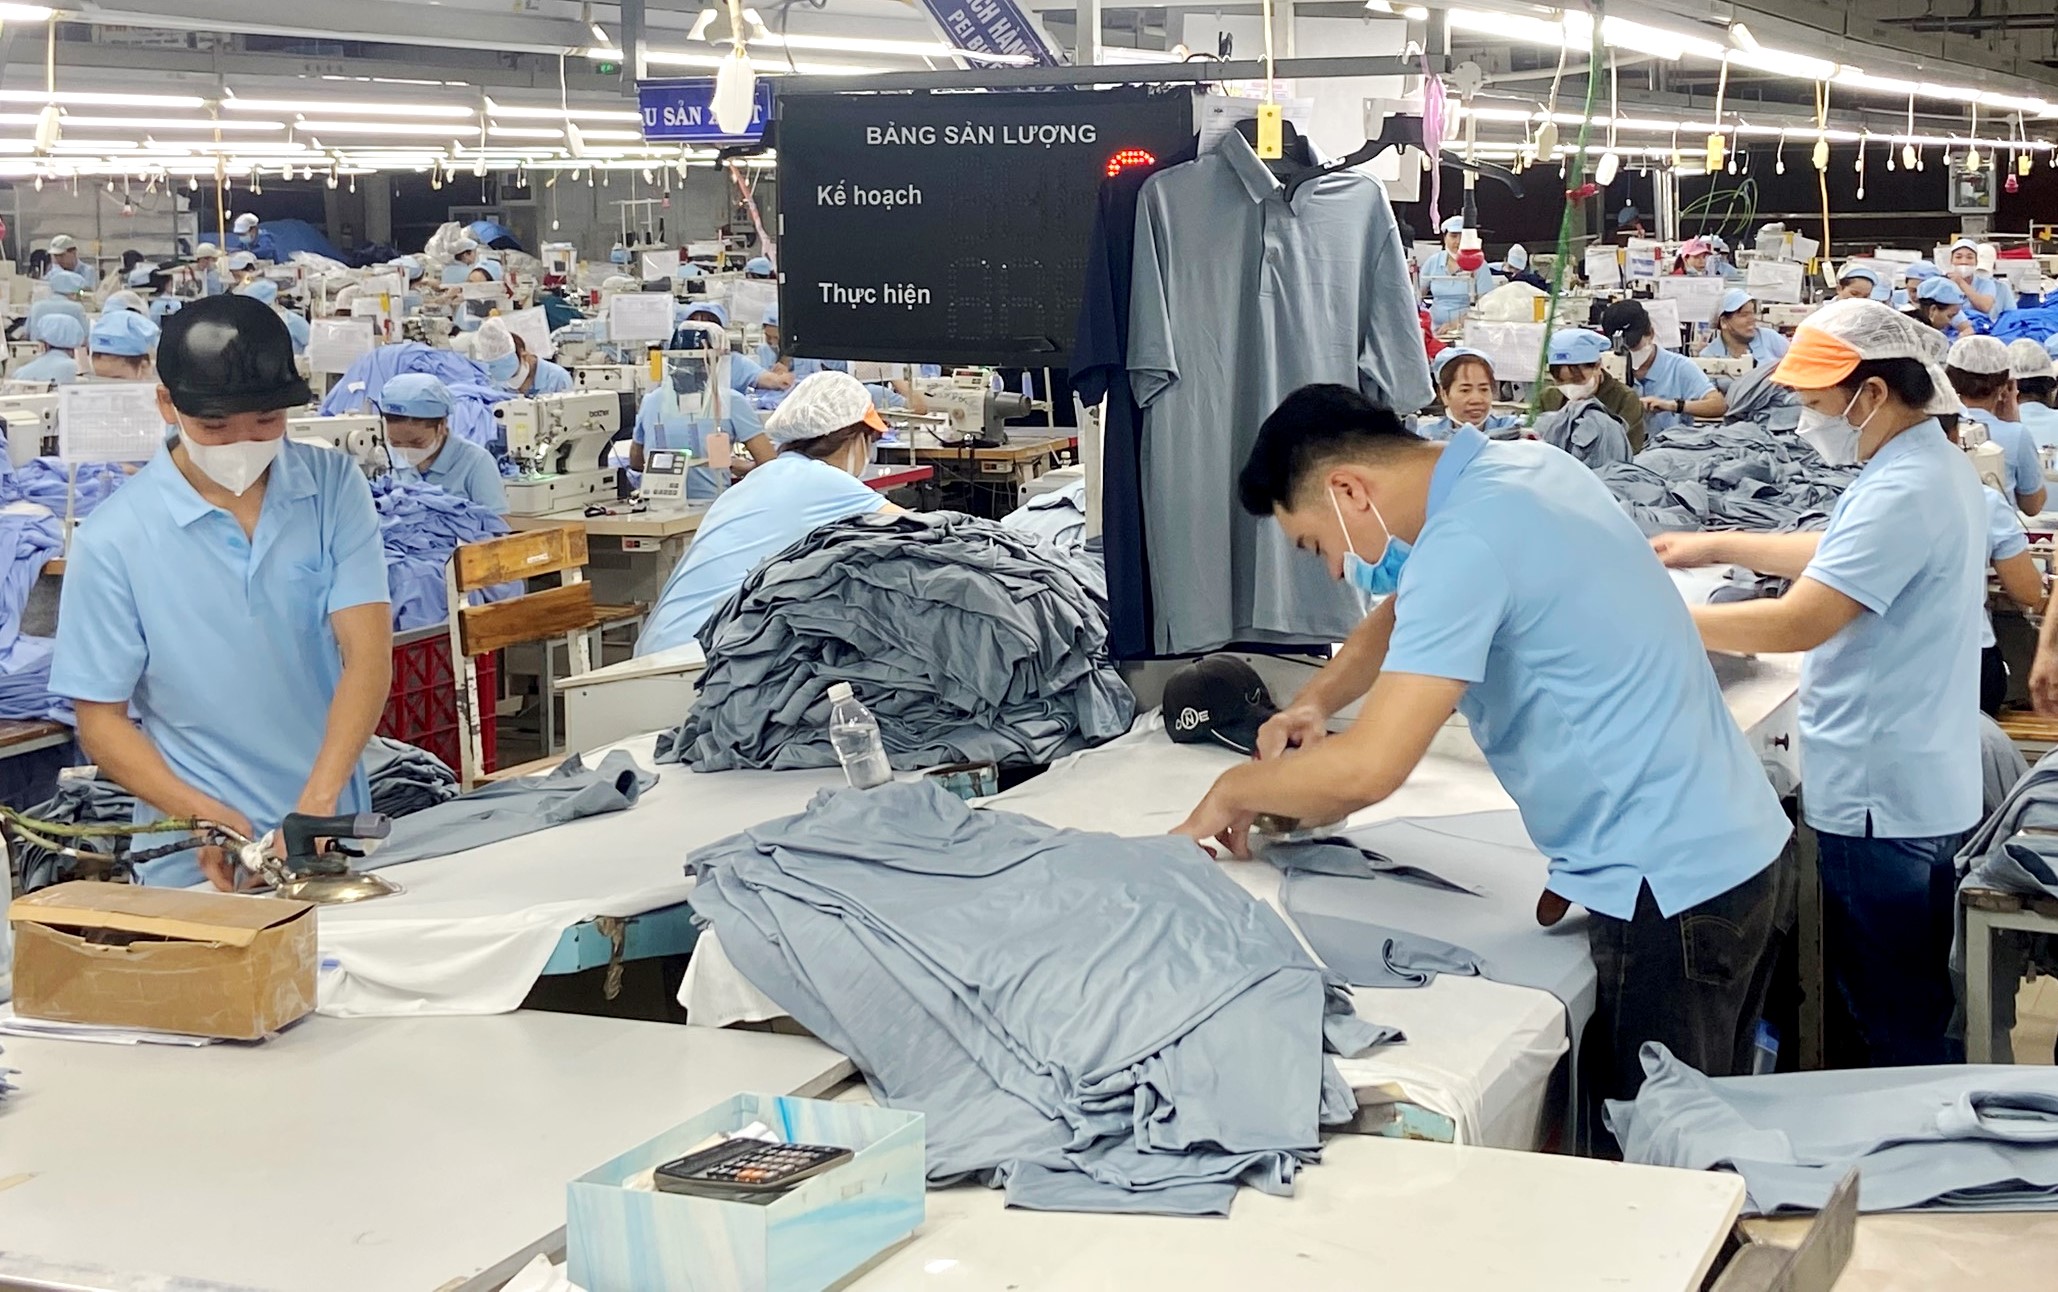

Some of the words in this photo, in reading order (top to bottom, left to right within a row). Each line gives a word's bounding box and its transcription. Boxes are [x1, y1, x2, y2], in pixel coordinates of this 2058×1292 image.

[947, 8, 975, 39] PEI
[663, 99, 702, 126] SẢN
[866, 120, 936, 145] BẢNG
[944, 120, 995, 145] SẢN
[1003, 124, 1097, 149] LƯỢNG
[817, 179, 847, 206] Kế
[853, 184, 922, 210] hoạch
[818, 282, 877, 309] Thực
[884, 282, 931, 310] hiện
